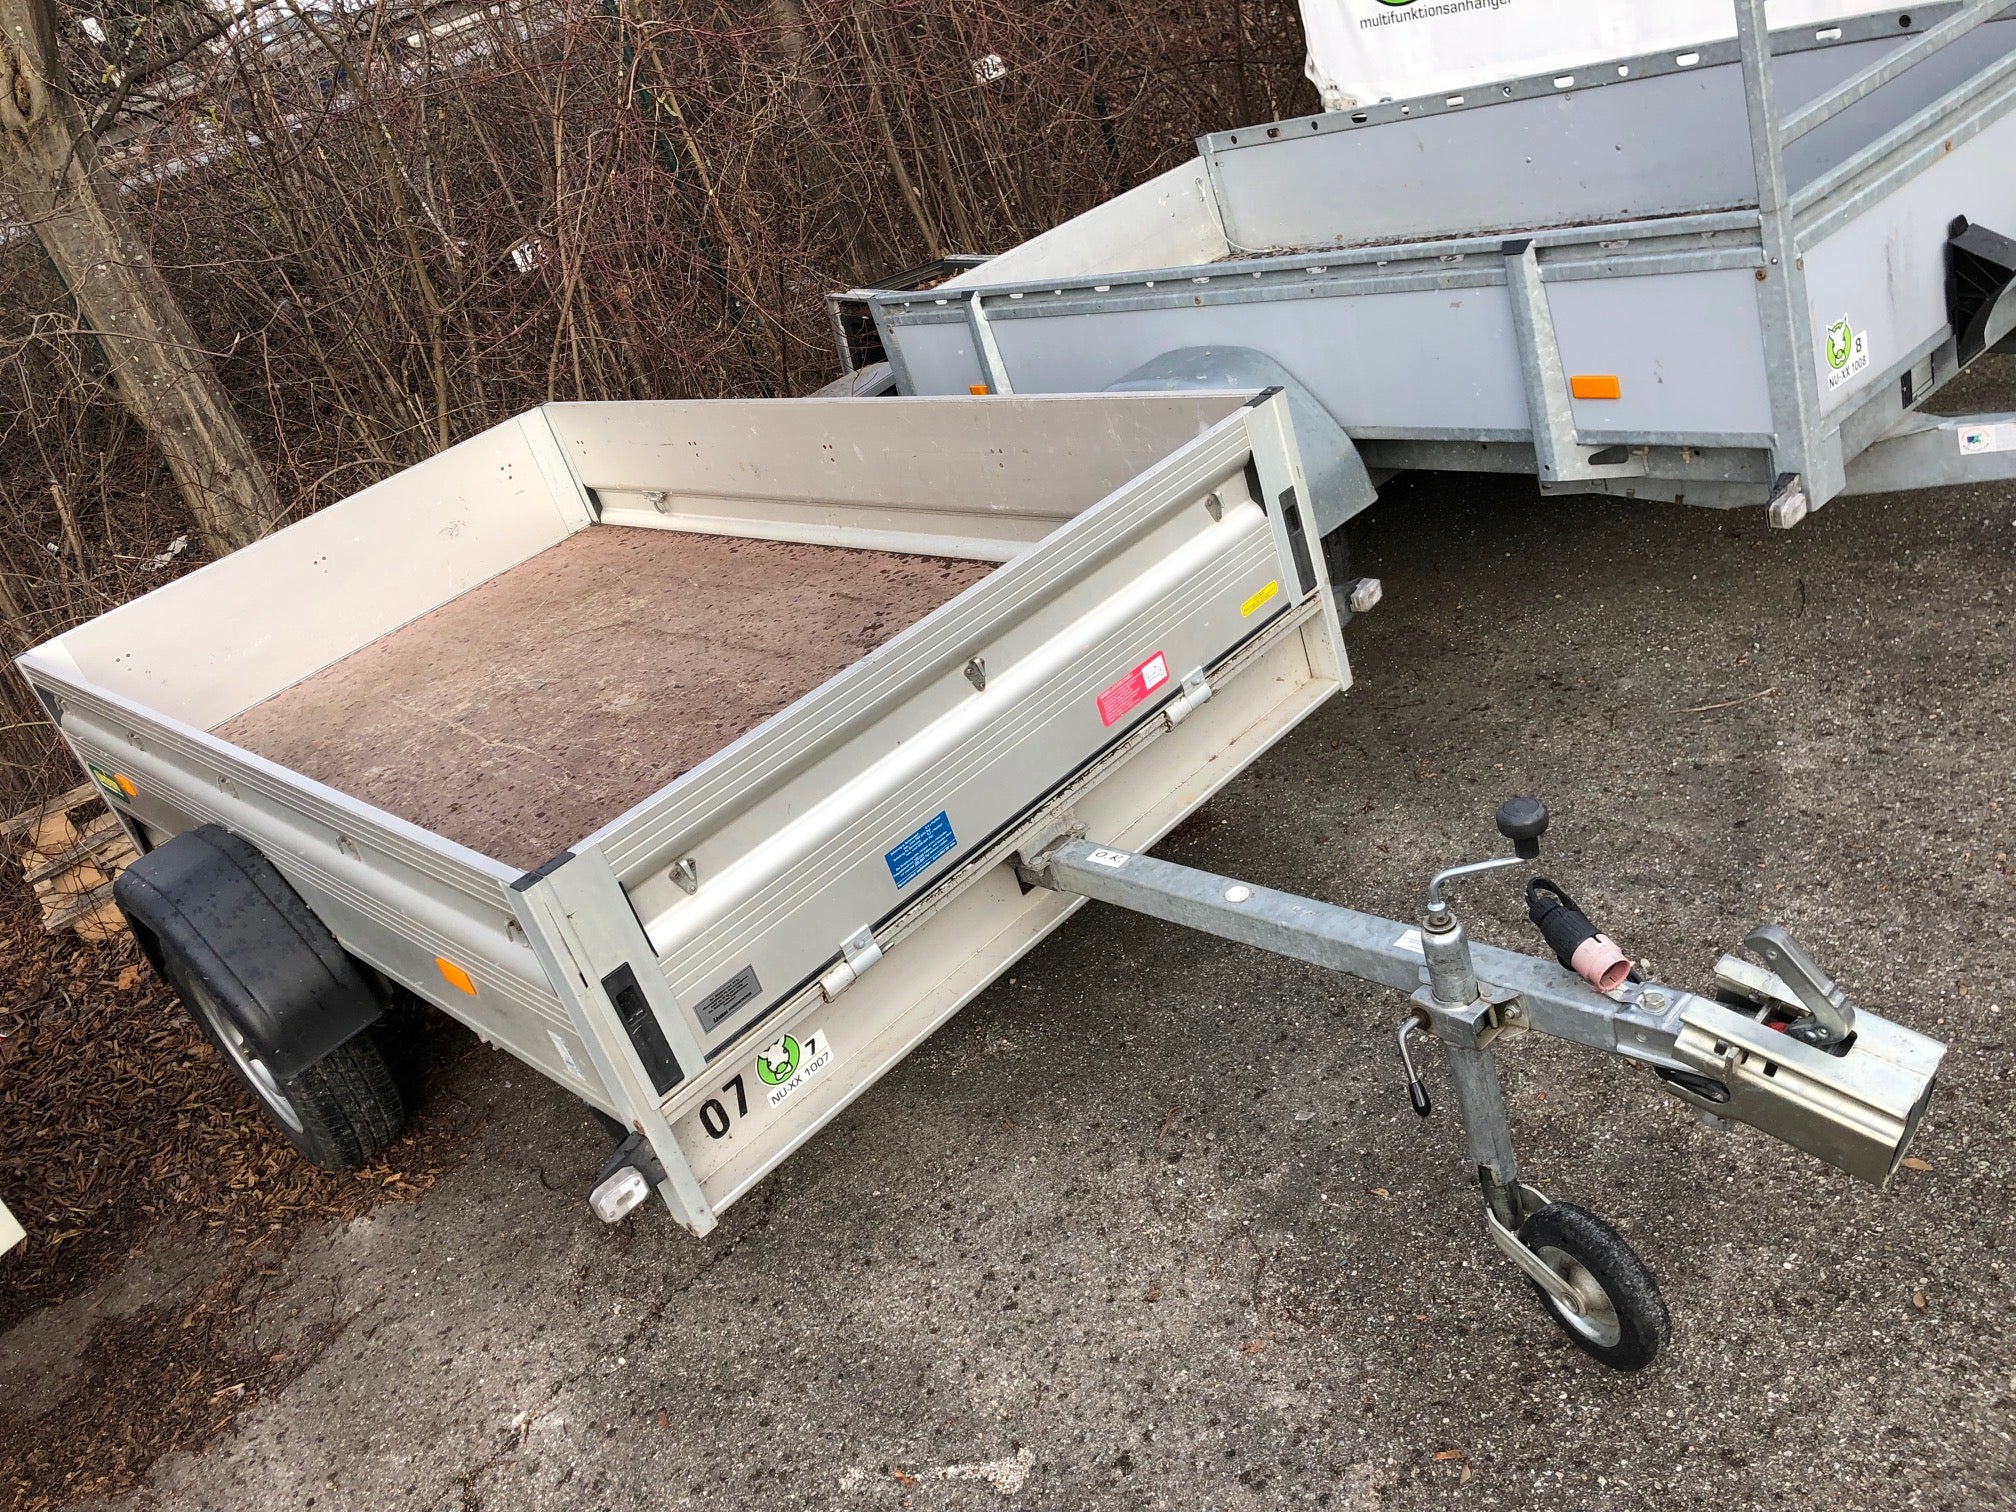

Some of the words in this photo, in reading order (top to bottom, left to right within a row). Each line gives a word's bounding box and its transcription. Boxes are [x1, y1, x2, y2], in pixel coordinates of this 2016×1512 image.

[1856, 337, 1862, 353] 8
[805, 1038, 816, 1055] 7
[771, 1074, 803, 1105] NU-XX
[804, 1051, 829, 1076] 1007
[699, 1073, 748, 1139] 07
